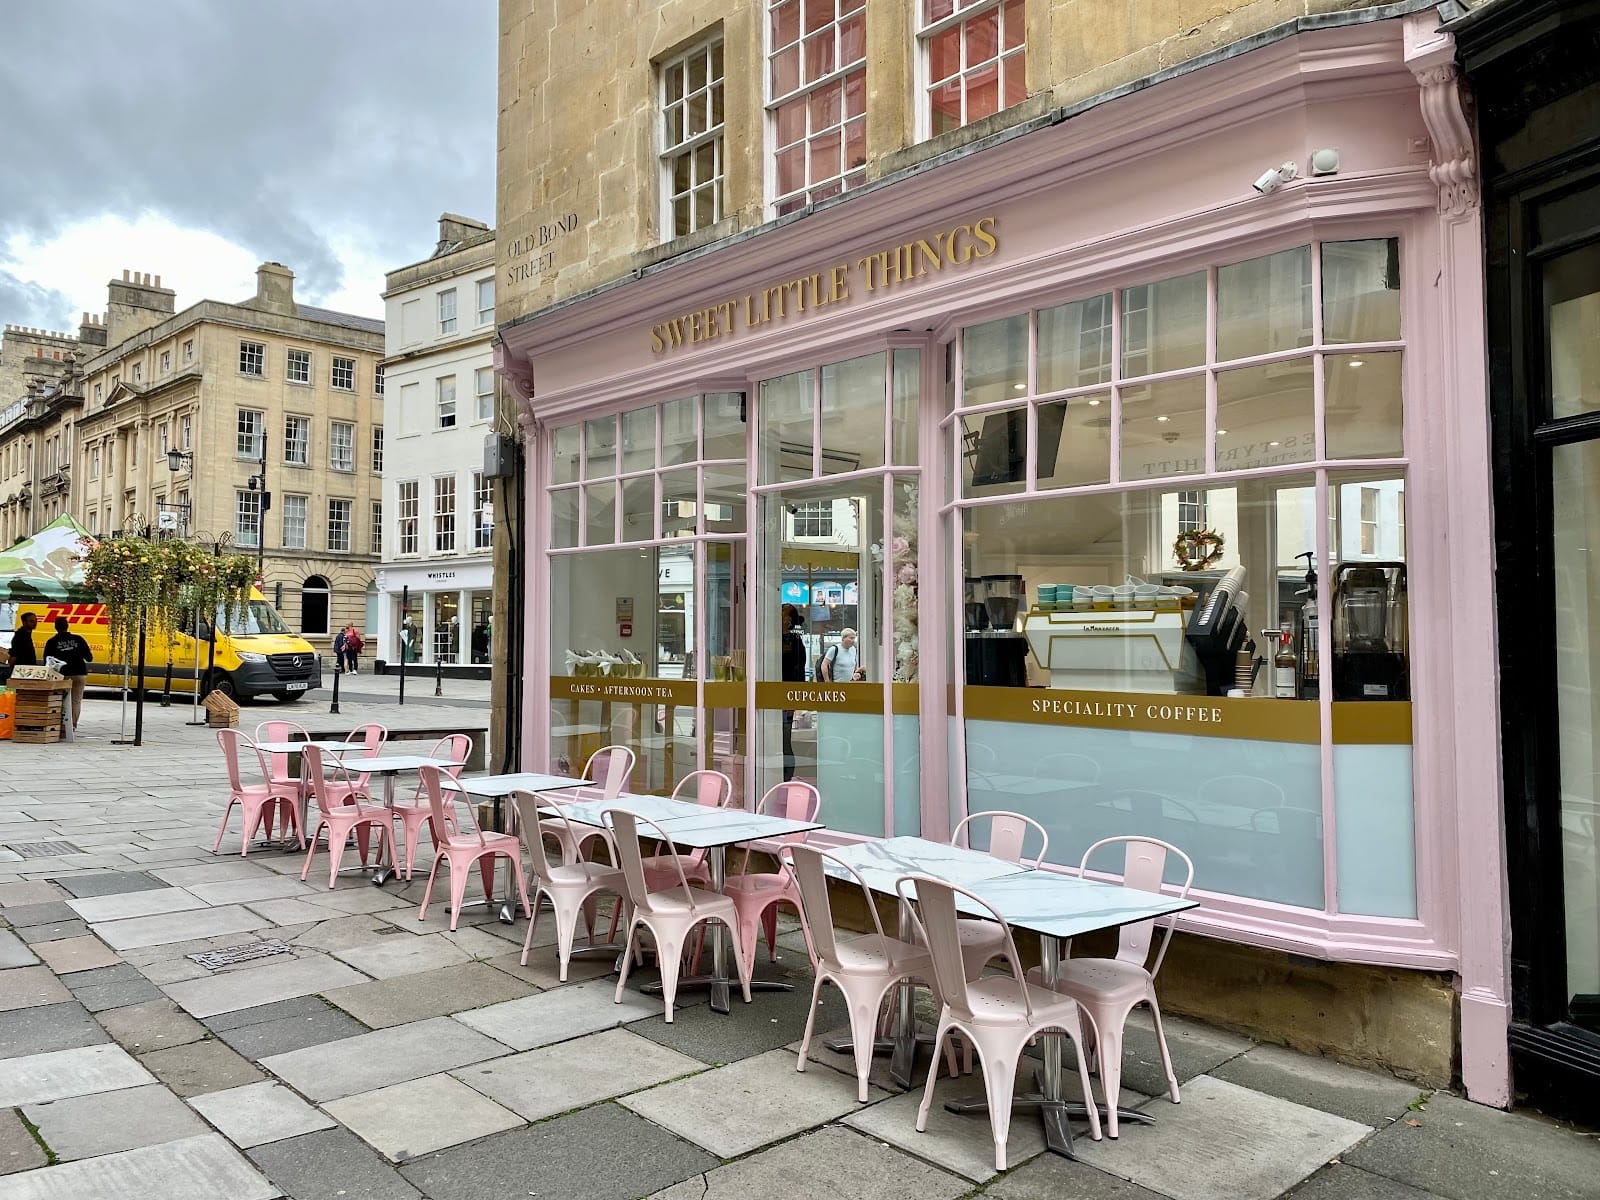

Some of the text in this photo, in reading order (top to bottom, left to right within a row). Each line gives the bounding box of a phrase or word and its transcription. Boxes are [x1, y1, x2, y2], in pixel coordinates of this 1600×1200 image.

[508, 213, 578, 259] OLD BOND
[507, 251, 556, 287] STREET
[651, 216, 997, 354] SWEET LITTLE THINGS
[427, 571, 456, 579] WHISTLES
[570, 683, 673, 698] CAKES AFTERNOON TEA
[787, 690, 847, 702] CUPCAKES
[1032, 699, 1223, 723] SPECIALITY COFFEE
